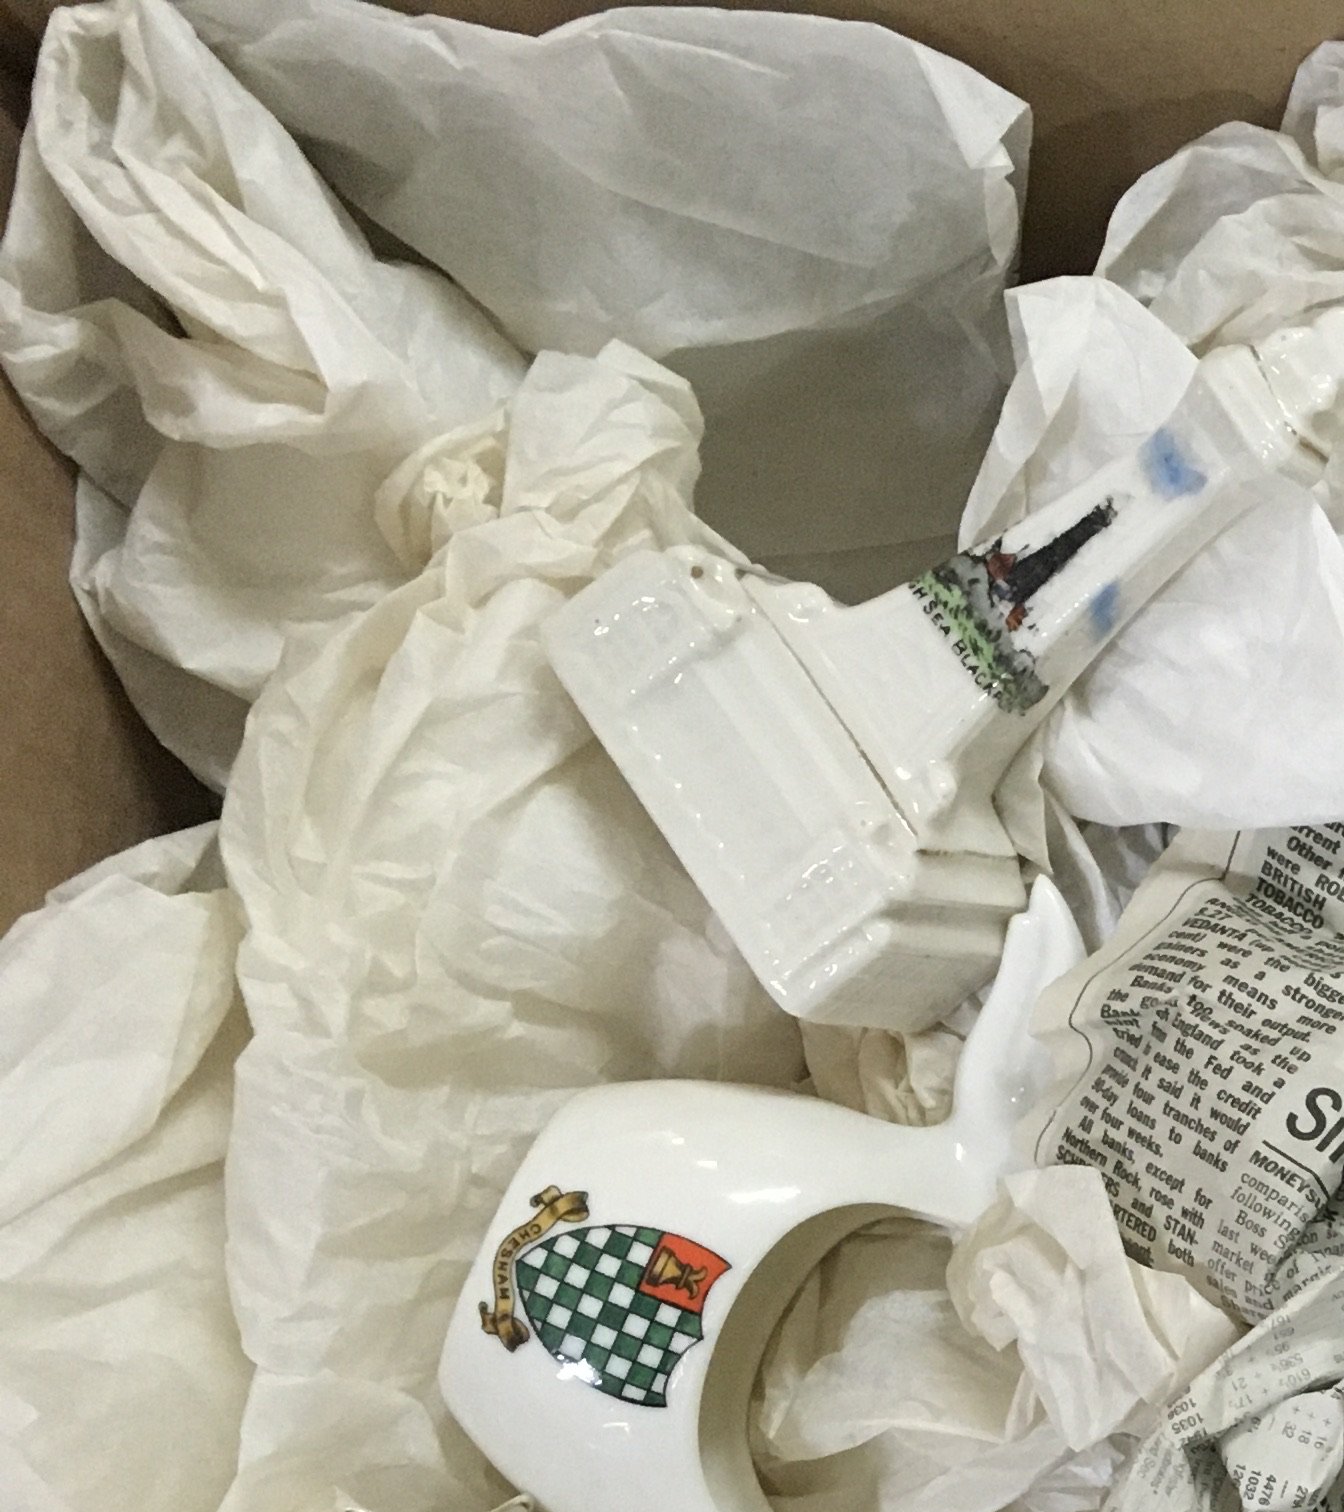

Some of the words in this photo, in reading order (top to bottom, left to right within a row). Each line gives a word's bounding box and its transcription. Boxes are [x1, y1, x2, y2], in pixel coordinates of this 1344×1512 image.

[922, 601, 951, 636] SEA
[1267, 847, 1300, 875] were
[1288, 836, 1332, 870] Other
[1257, 877, 1324, 929] TOBACCO
[1261, 861, 1326, 911] BRITISH
[1182, 918, 1248, 942] VEDANTA
[1217, 941, 1251, 957] were
[1264, 957, 1290, 972] the
[1220, 958, 1240, 969] as
[1255, 970, 1266, 980] a
[1142, 953, 1206, 972] economy
[1222, 975, 1278, 1010] means
[1296, 1015, 1336, 1034] more
[1189, 976, 1212, 993] for
[1217, 990, 1257, 1019] their
[1262, 1018, 1309, 1042] output.
[1171, 1014, 1224, 1051] England
[1230, 1051, 1265, 1075] took
[1273, 1077, 1286, 1089] a
[1225, 1019, 1282, 1046] soaked
[1289, 1047, 1311, 1063] up
[1240, 1042, 1261, 1055] as
[1271, 1054, 1298, 1074] the
[1153, 1052, 1180, 1074] ease
[1187, 1069, 1208, 1090] the
[1217, 1088, 1262, 1120] credit
[1174, 1038, 1194, 1059] the
[1204, 1055, 1234, 1079] Fed
[1241, 1078, 1275, 1105] and
[1133, 1081, 1155, 1104] four
[1163, 1101, 1218, 1142] tranches
[1224, 1139, 1241, 1154] of
[1141, 1064, 1152, 1080] it
[1157, 1076, 1183, 1099] said
[1190, 1092, 1201, 1109] it
[1209, 1106, 1251, 1136] would
[1080, 1095, 1099, 1113] over
[1100, 1107, 1124, 1131] four
[1128, 1125, 1163, 1157] weeks.
[1127, 1100, 1156, 1130] loans
[1168, 1128, 1182, 1144] to
[1193, 1141, 1229, 1173] banks
[1063, 1127, 1107, 1167] Northern
[1113, 1159, 1141, 1192] Rock,
[1150, 1187, 1174, 1209] rose
[1181, 1204, 1205, 1229] with
[1079, 1116, 1094, 1134] All
[1102, 1130, 1135, 1164] banks,
[1146, 1162, 1186, 1193] except
[1194, 1188, 1213, 1209] for
[1131, 1198, 1153, 1218] and
[1164, 1215, 1199, 1245] STAN-
[1240, 1172, 1308, 1223] comparis
[1217, 1220, 1240, 1244] last
[1235, 1210, 1267, 1238] Boss
[496, 1222, 542, 1300] CHESHAM
[1168, 1240, 1194, 1267] both
[1208, 1257, 1236, 1282] offer
[1212, 1240, 1254, 1274] market
